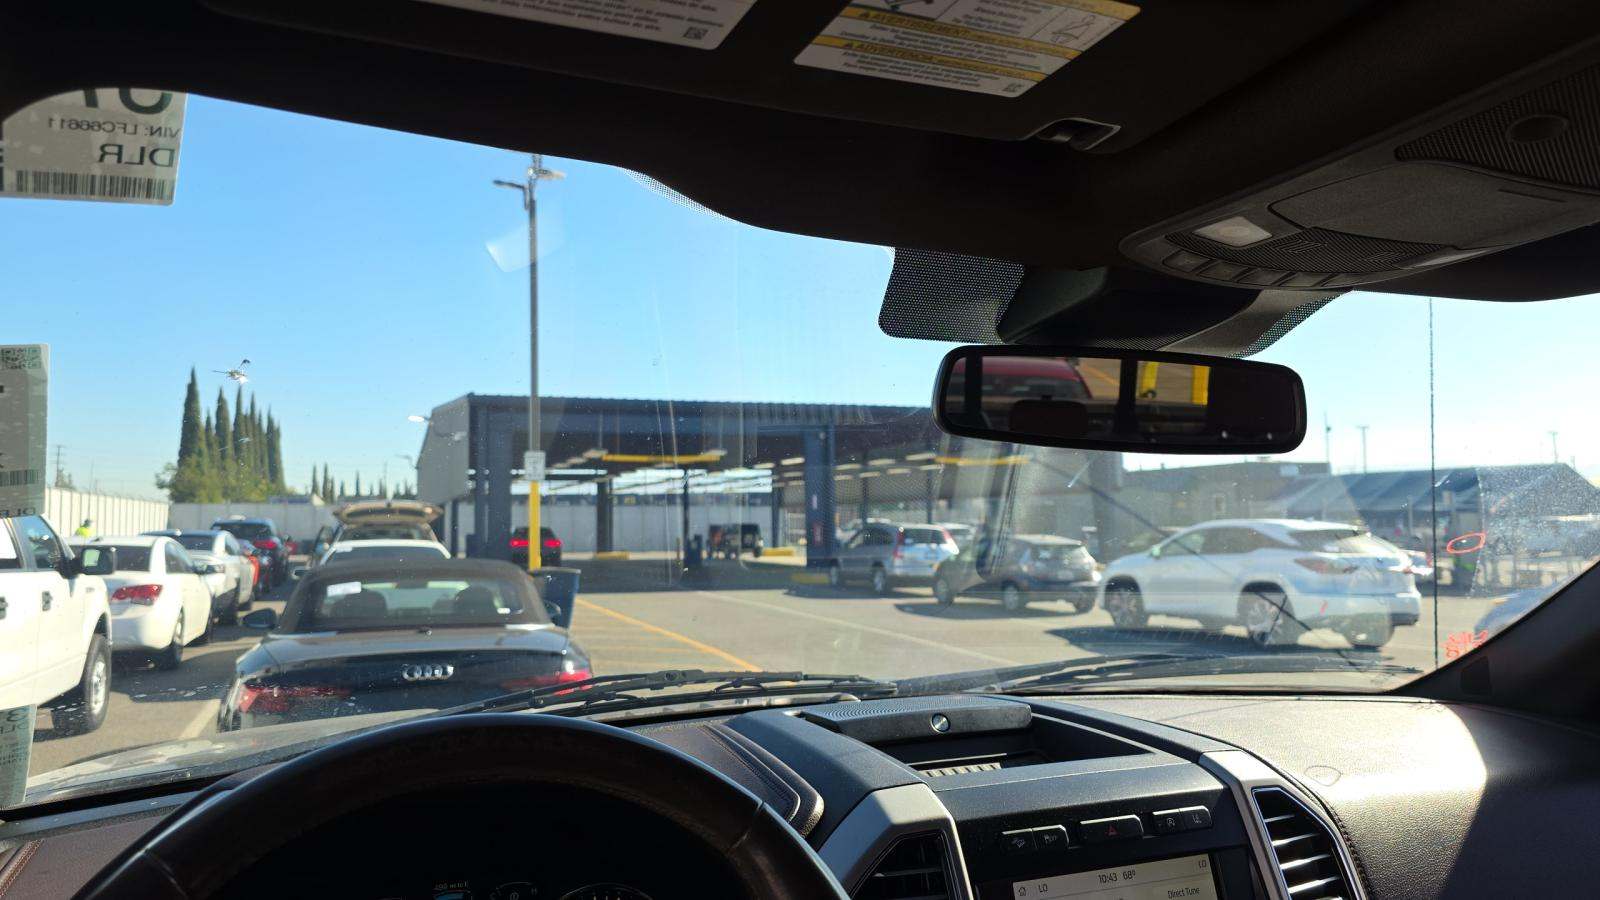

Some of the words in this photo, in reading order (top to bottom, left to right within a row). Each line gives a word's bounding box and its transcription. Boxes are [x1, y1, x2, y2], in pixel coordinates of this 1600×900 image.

[1098, 872, 1118, 884] 10:43
[1167, 888, 1185, 900] Direct
[1186, 887, 1201, 897] Tune
